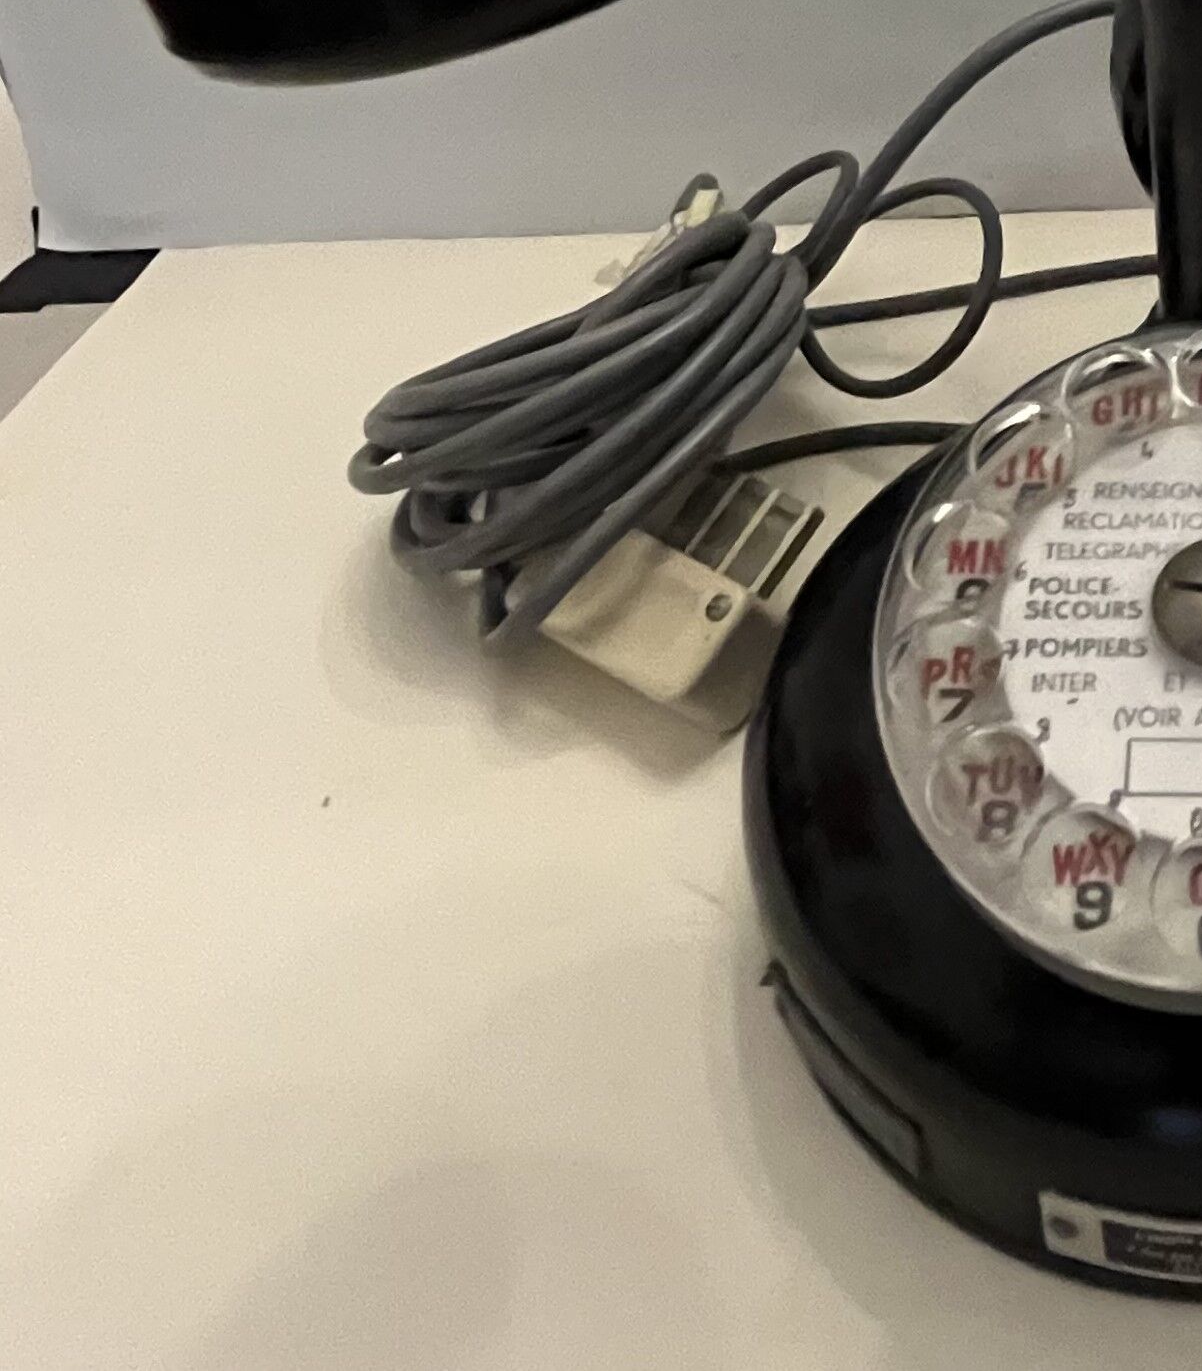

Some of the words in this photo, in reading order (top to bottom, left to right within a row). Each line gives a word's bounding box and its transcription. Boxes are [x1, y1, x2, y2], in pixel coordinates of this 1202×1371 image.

[1091, 384, 1160, 426] GHI
[946, 538, 1008, 575] MN
[1045, 540, 1178, 561] TELEGRAPH
[1028, 576, 1121, 597] POLICE-
[1023, 599, 1144, 621] SECOURS
[1024, 637, 1149, 659] POMPIERS
[1030, 672, 1099, 693] INTER
[937, 688, 977, 723] 7
[1112, 705, 1183, 733] (VOIR
[977, 799, 1020, 842] 8
[1052, 831, 1137, 888] WXY
[1073, 881, 1114, 932] 9
